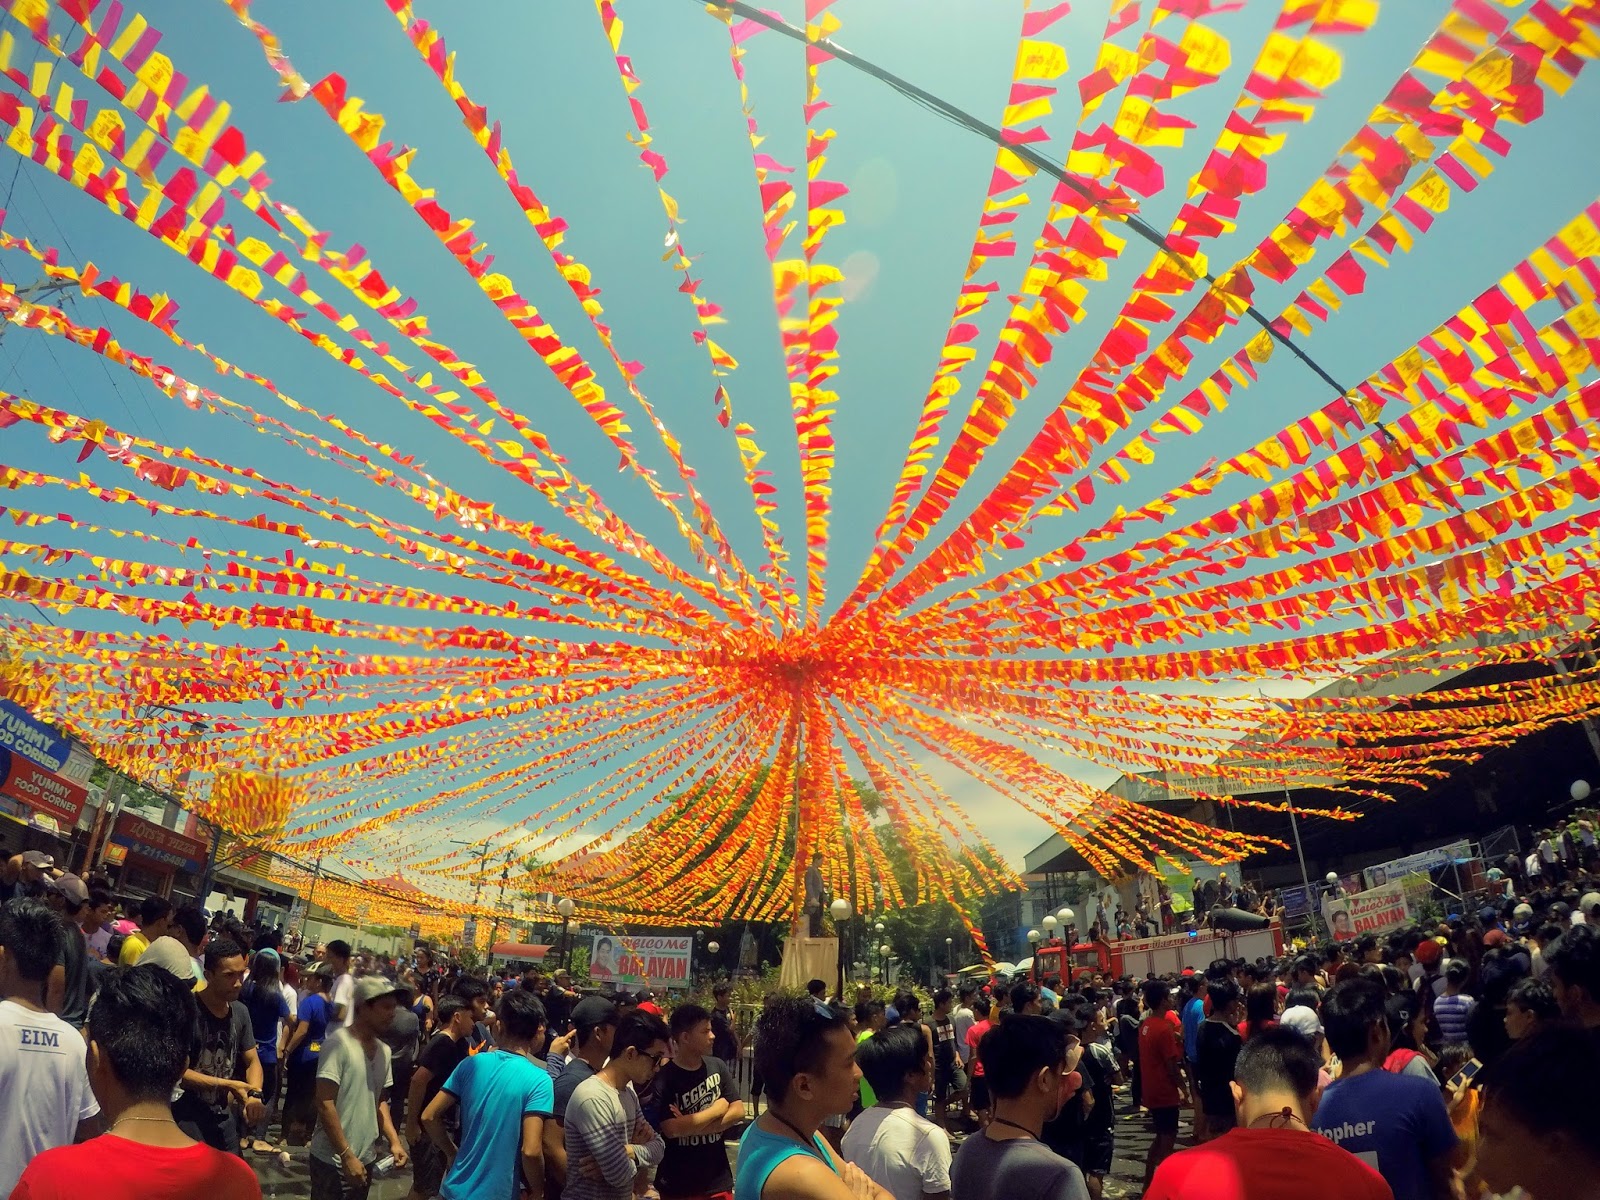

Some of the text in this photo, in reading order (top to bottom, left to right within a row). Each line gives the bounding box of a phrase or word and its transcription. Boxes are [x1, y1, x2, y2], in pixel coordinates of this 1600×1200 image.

[15, 738, 60, 772] CORNER
[13, 777, 41, 796] FOOD
[42, 791, 78, 814] CORNER
[31, 771, 72, 799] YUMMY
[167, 837, 198, 856] PIZZA
[1354, 906, 1405, 933] BALAYAN
[1149, 938, 1182, 950] BUREAU
[1184, 935, 1195, 944] OF
[618, 955, 688, 979] BALAYAN
[21, 1029, 59, 1047] EIM
